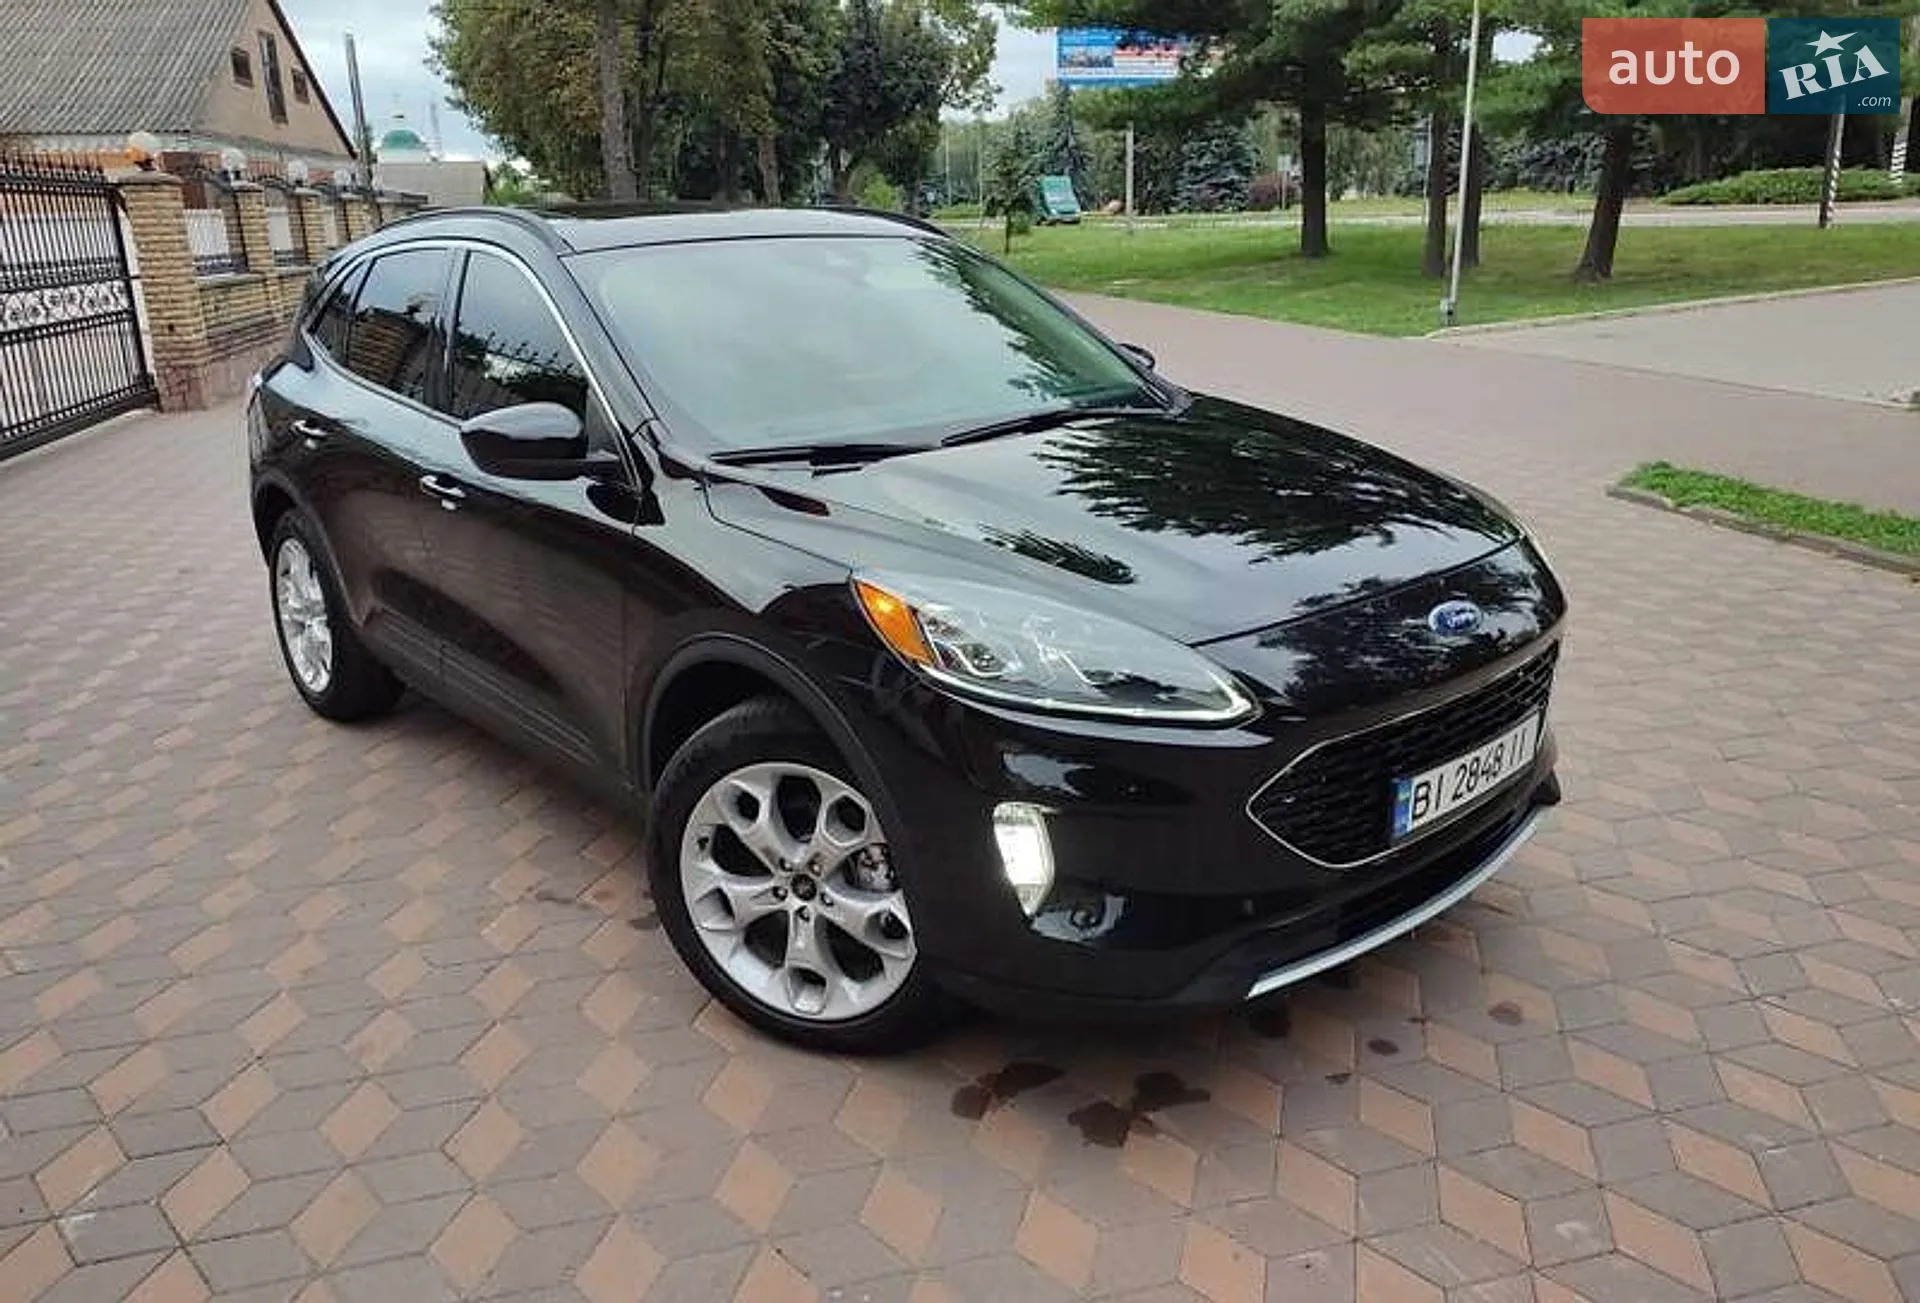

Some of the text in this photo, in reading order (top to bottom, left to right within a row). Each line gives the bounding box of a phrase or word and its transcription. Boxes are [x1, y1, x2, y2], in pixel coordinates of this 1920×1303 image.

[1413, 728, 1527, 819] BI 2848 II
